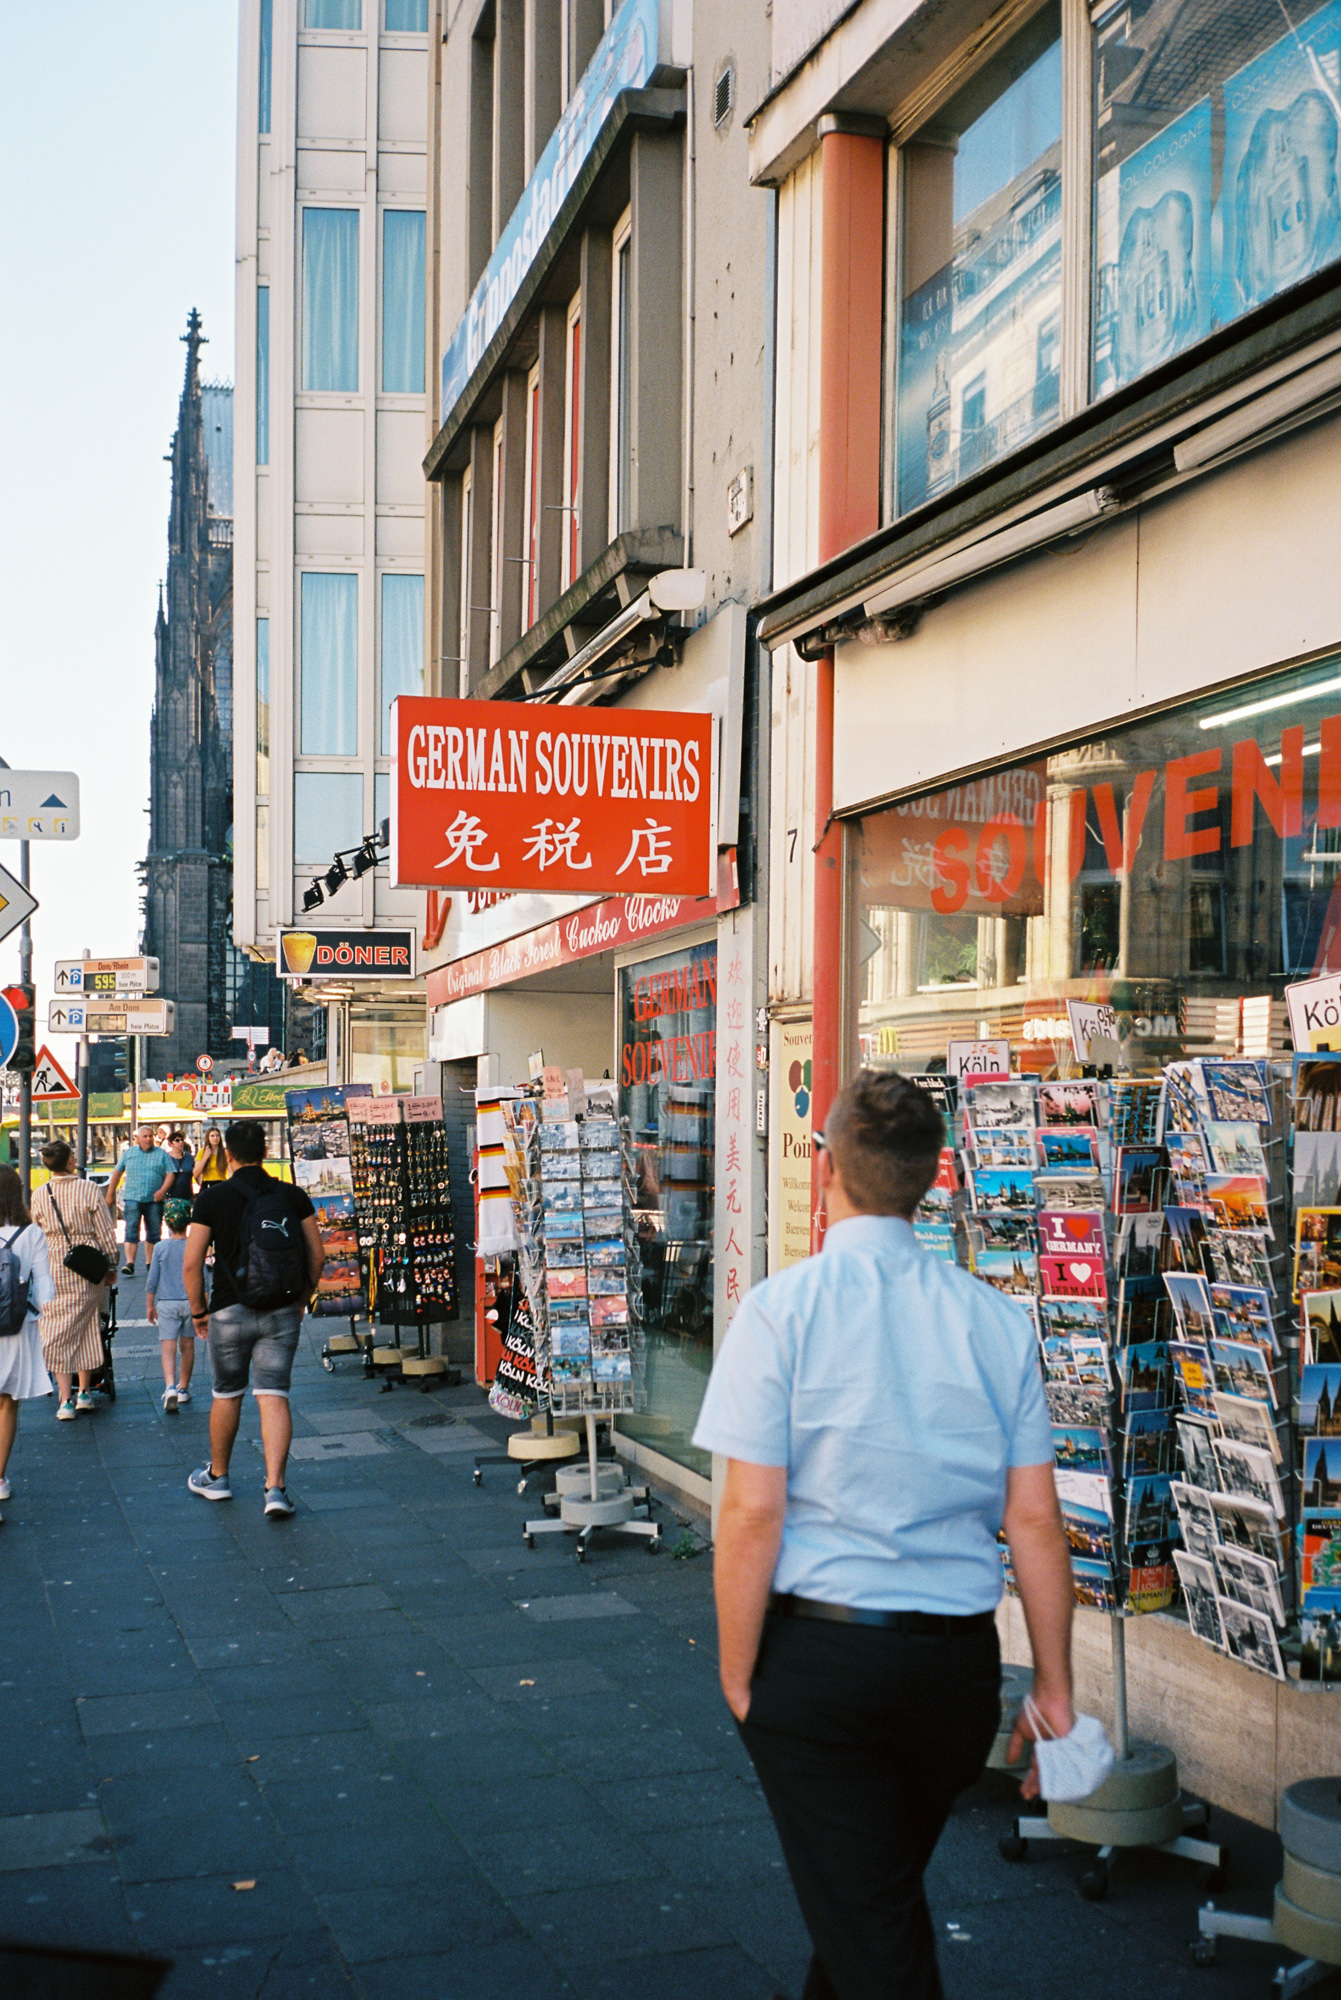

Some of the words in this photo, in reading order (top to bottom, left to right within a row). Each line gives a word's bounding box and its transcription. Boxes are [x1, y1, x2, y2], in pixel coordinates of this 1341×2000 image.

[1143, 118, 1206, 177] COLOGNE
[407, 724, 529, 793] GERMAN
[535, 730, 700, 803] SOUVENIRS
[433, 809, 674, 876] 免税店
[787, 827, 798, 864] 7
[316, 941, 409, 965] DÖNER
[447, 957, 485, 997] Original
[489, 947, 522, 981] Black
[522, 921, 563, 969] Forest
[566, 909, 622, 952] Cuckoo
[625, 896, 681, 932] Clocks
[98, 962, 129, 971] Dom/Rhein
[95, 974, 116, 990] 595
[634, 957, 717, 1022] GERMAN
[109, 1003, 121, 1012] Am
[123, 1003, 140, 1012] Dom
[1079, 1017, 1112, 1041] Köln
[958, 1055, 1000, 1077] Köln
[725, 950, 745, 1330] 欢迎使用美元人民
[1051, 1217, 1066, 1238] I
[1046, 1240, 1101, 1254] GERMANY
[1054, 1262, 1068, 1281] I
[1051, 1285, 1102, 1298] GERMANY
[506, 1336, 535, 1358] KÖLN
[499, 1359, 525, 1383] KÖLN
[496, 1393, 521, 1413] KÖLN
[1142, 1567, 1162, 1577] CALM
[1141, 1581, 1160, 1591] LOVE
